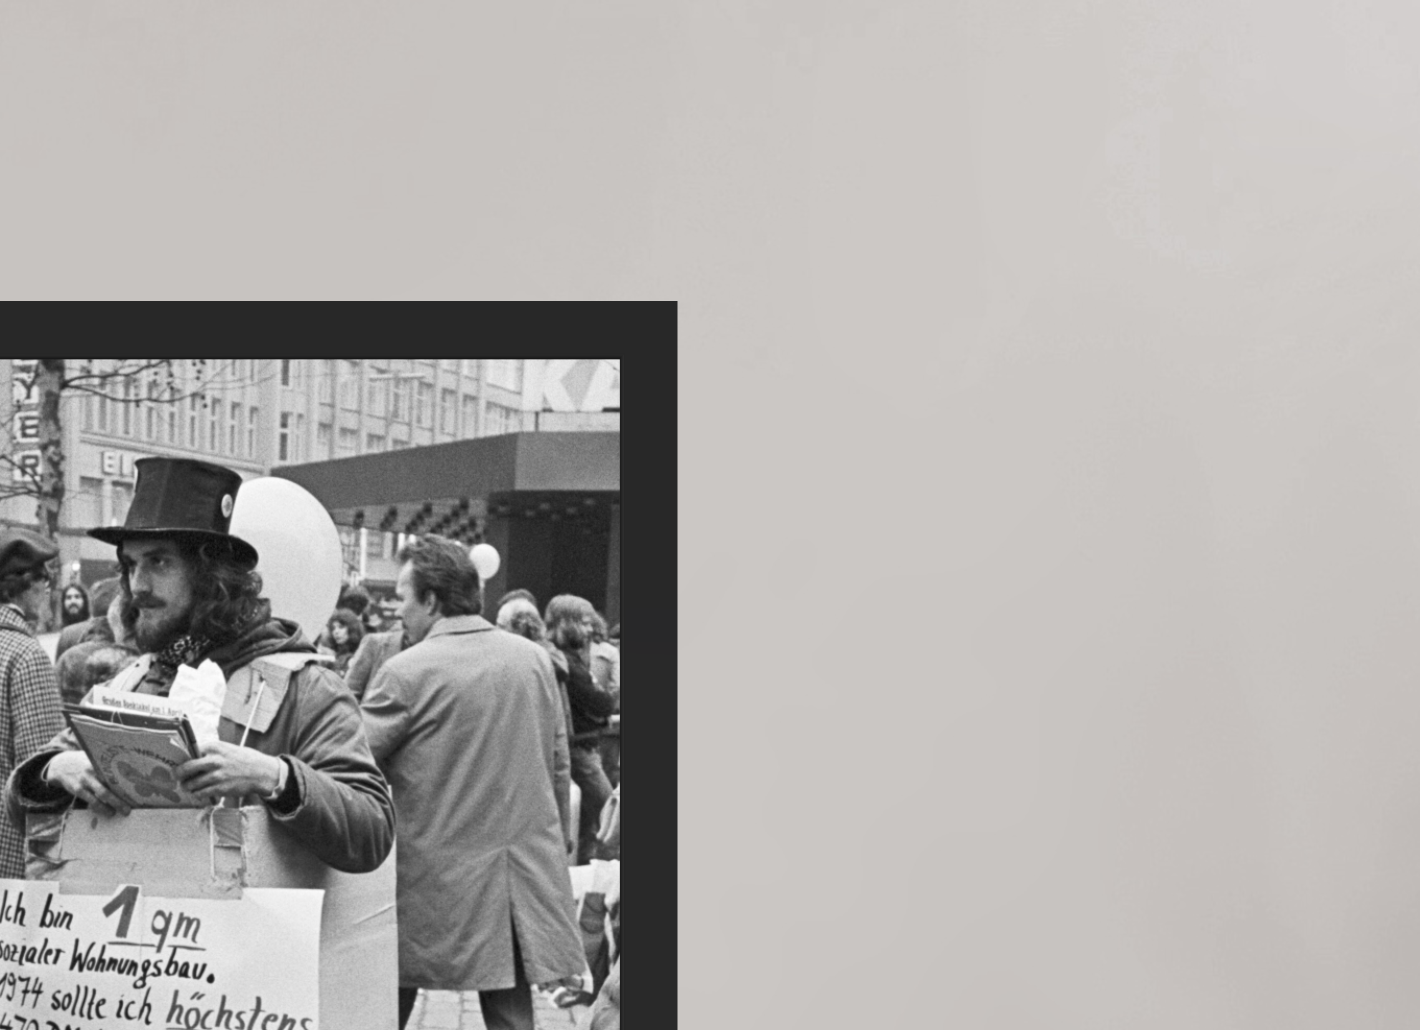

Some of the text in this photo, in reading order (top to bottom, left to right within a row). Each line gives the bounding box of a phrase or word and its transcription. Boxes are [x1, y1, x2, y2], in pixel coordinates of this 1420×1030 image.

[39, 893, 73, 930] bin
[102, 885, 139, 938] 1
[151, 909, 203, 953] qm
[69, 938, 215, 989] Wohnungsbau.
[51, 984, 107, 1021] sollte
[116, 986, 152, 1026] ich
